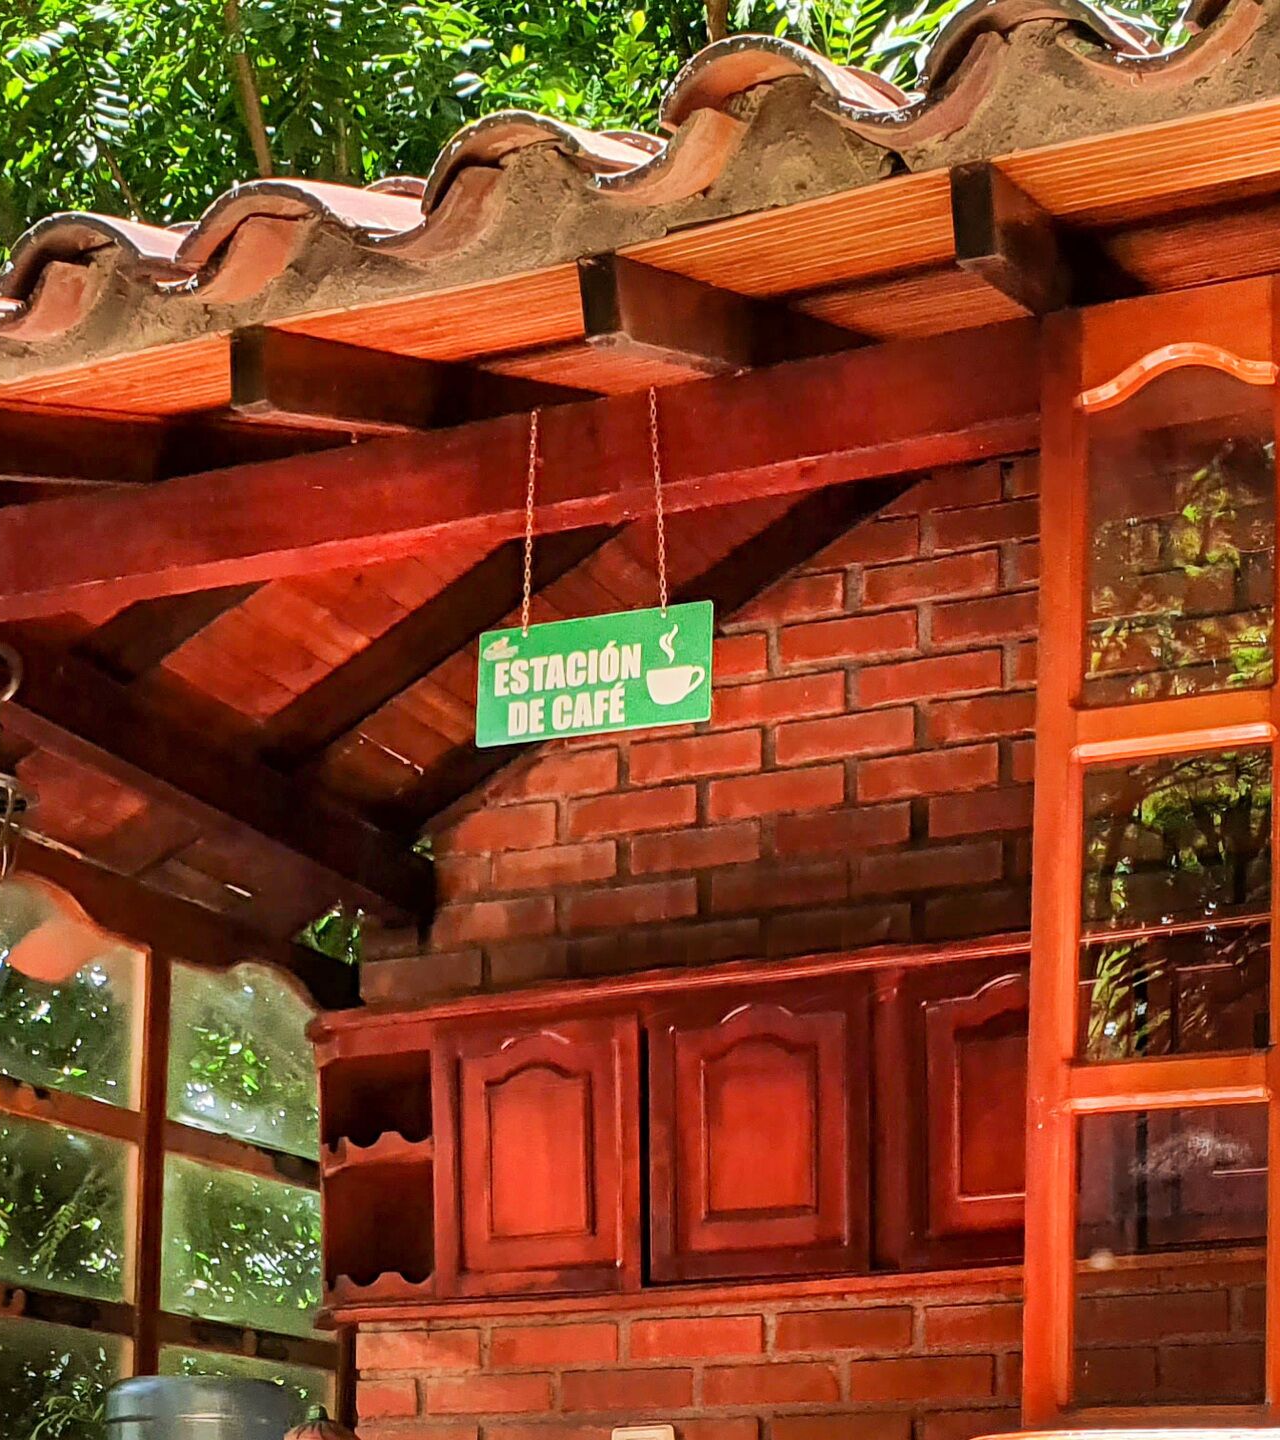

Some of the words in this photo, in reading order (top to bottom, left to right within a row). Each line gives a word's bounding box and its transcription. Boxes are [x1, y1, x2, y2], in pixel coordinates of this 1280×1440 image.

[494, 640, 642, 697] ESTACIÓN
[508, 698, 545, 736] DE
[552, 681, 626, 731] CAFÉ
